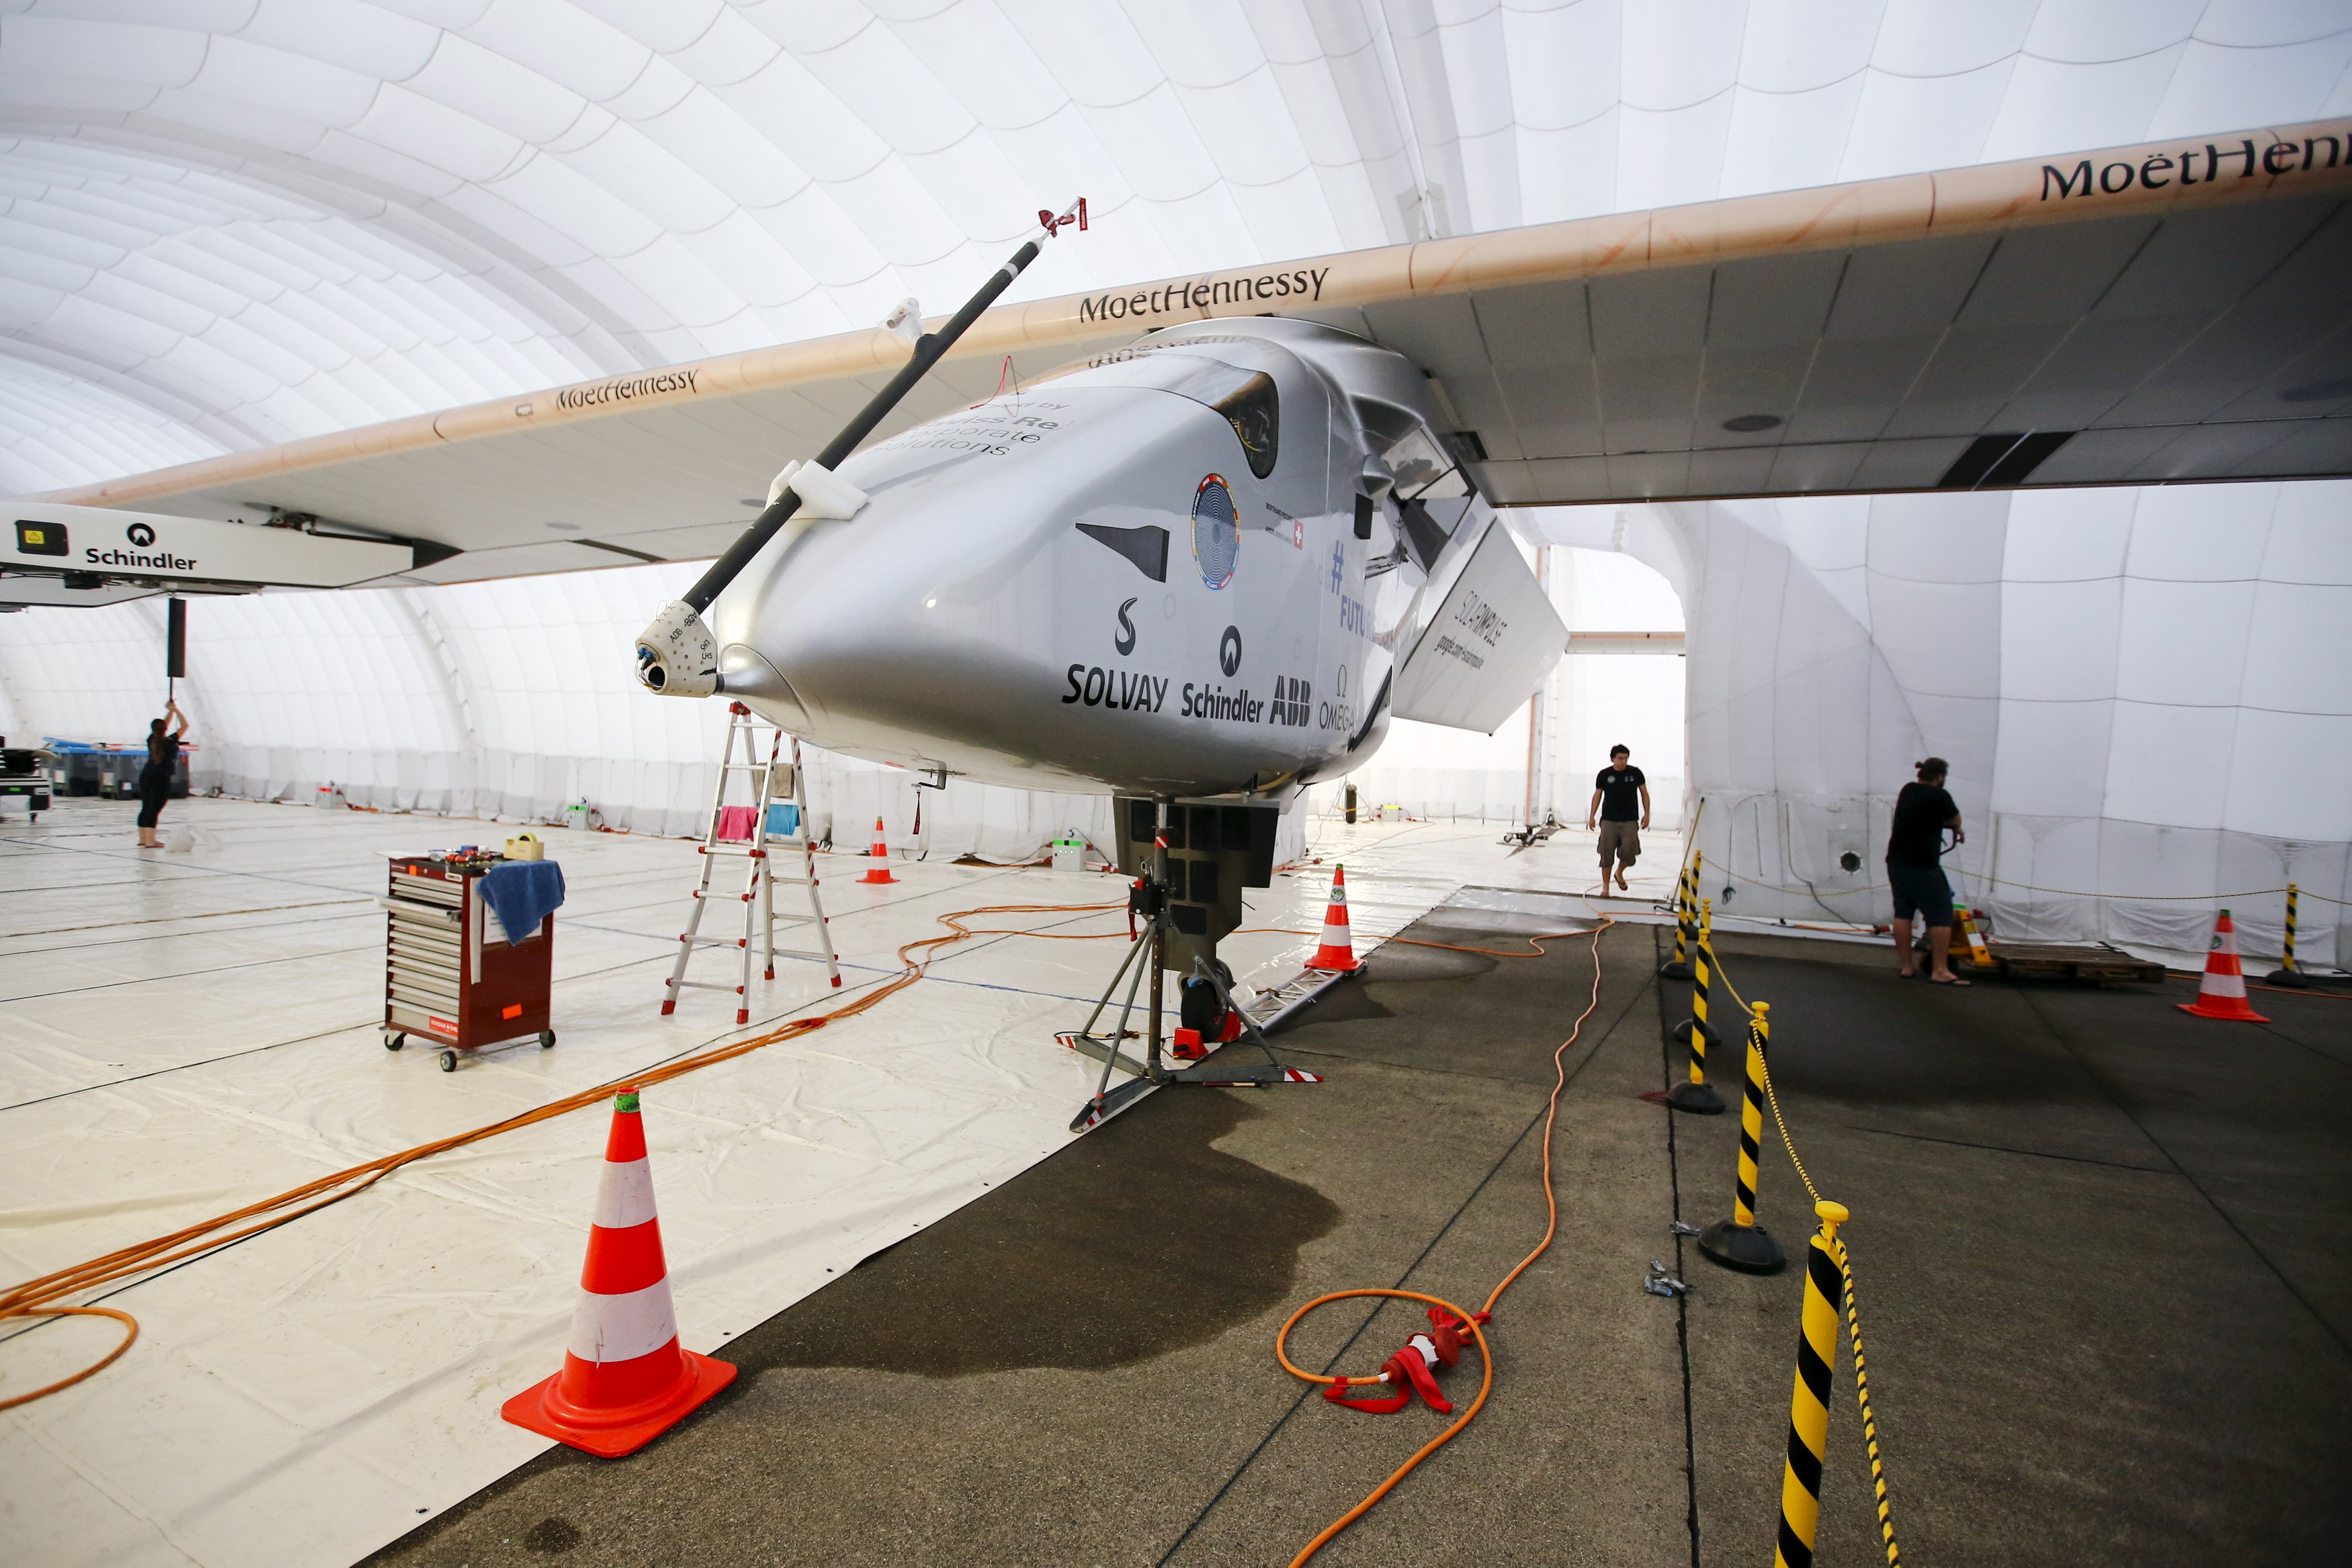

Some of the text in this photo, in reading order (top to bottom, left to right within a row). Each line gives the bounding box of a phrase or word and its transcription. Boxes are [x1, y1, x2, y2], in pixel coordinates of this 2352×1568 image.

[2041, 132, 2352, 201] MoëtHen
[1080, 267, 1331, 323] MoëtHennessy
[1013, 417, 1059, 429] Re
[86, 548, 196, 570] Schindler
[1062, 664, 1169, 713] SOLVAY
[1181, 683, 1264, 724] Schindler
[1269, 675, 1310, 727] ABB
[1319, 701, 1355, 732] OMEGA
